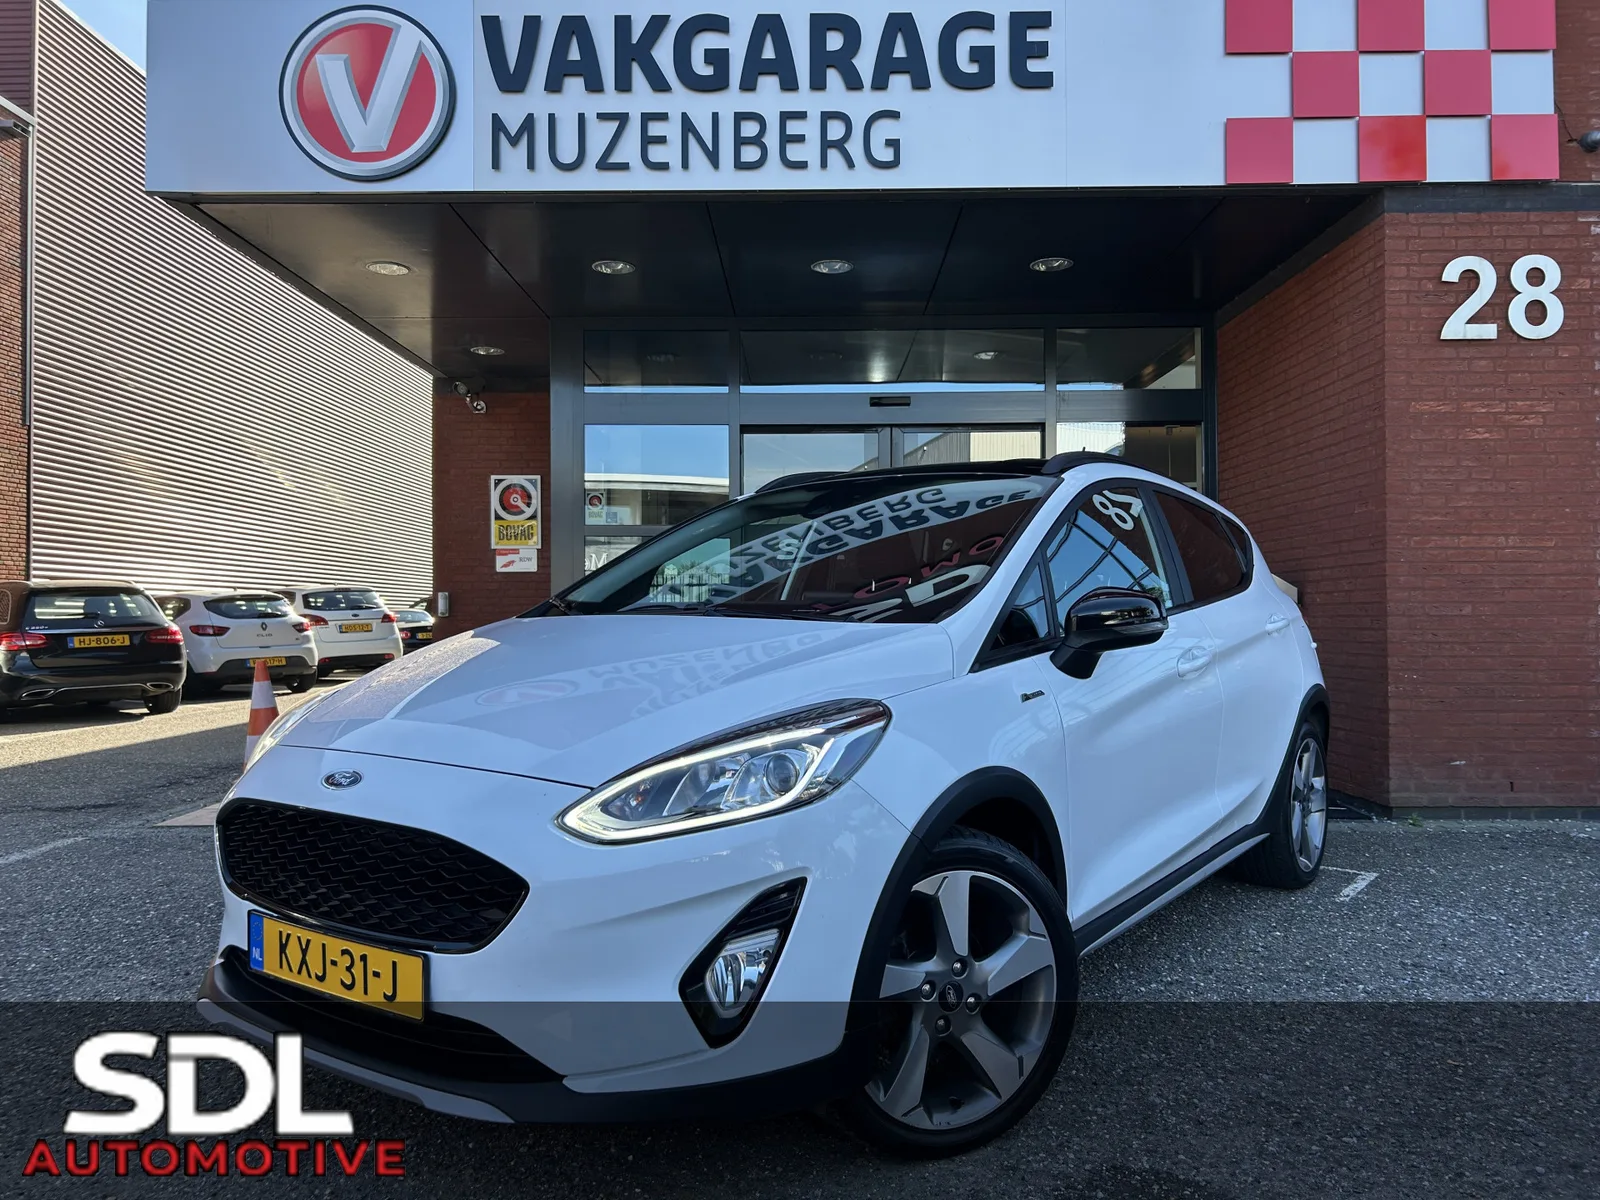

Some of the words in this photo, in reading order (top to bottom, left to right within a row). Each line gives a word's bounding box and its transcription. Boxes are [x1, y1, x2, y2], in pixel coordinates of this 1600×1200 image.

[481, 11, 1054, 92] VAKGARAGE
[492, 110, 901, 170] MUZENBERG
[1440, 254, 1565, 340] 28
[498, 524, 534, 541] BOVAG
[78, 635, 126, 646] HJ-806-J
[252, 947, 263, 961] NL
[278, 929, 398, 1003] KXJ-31-J
